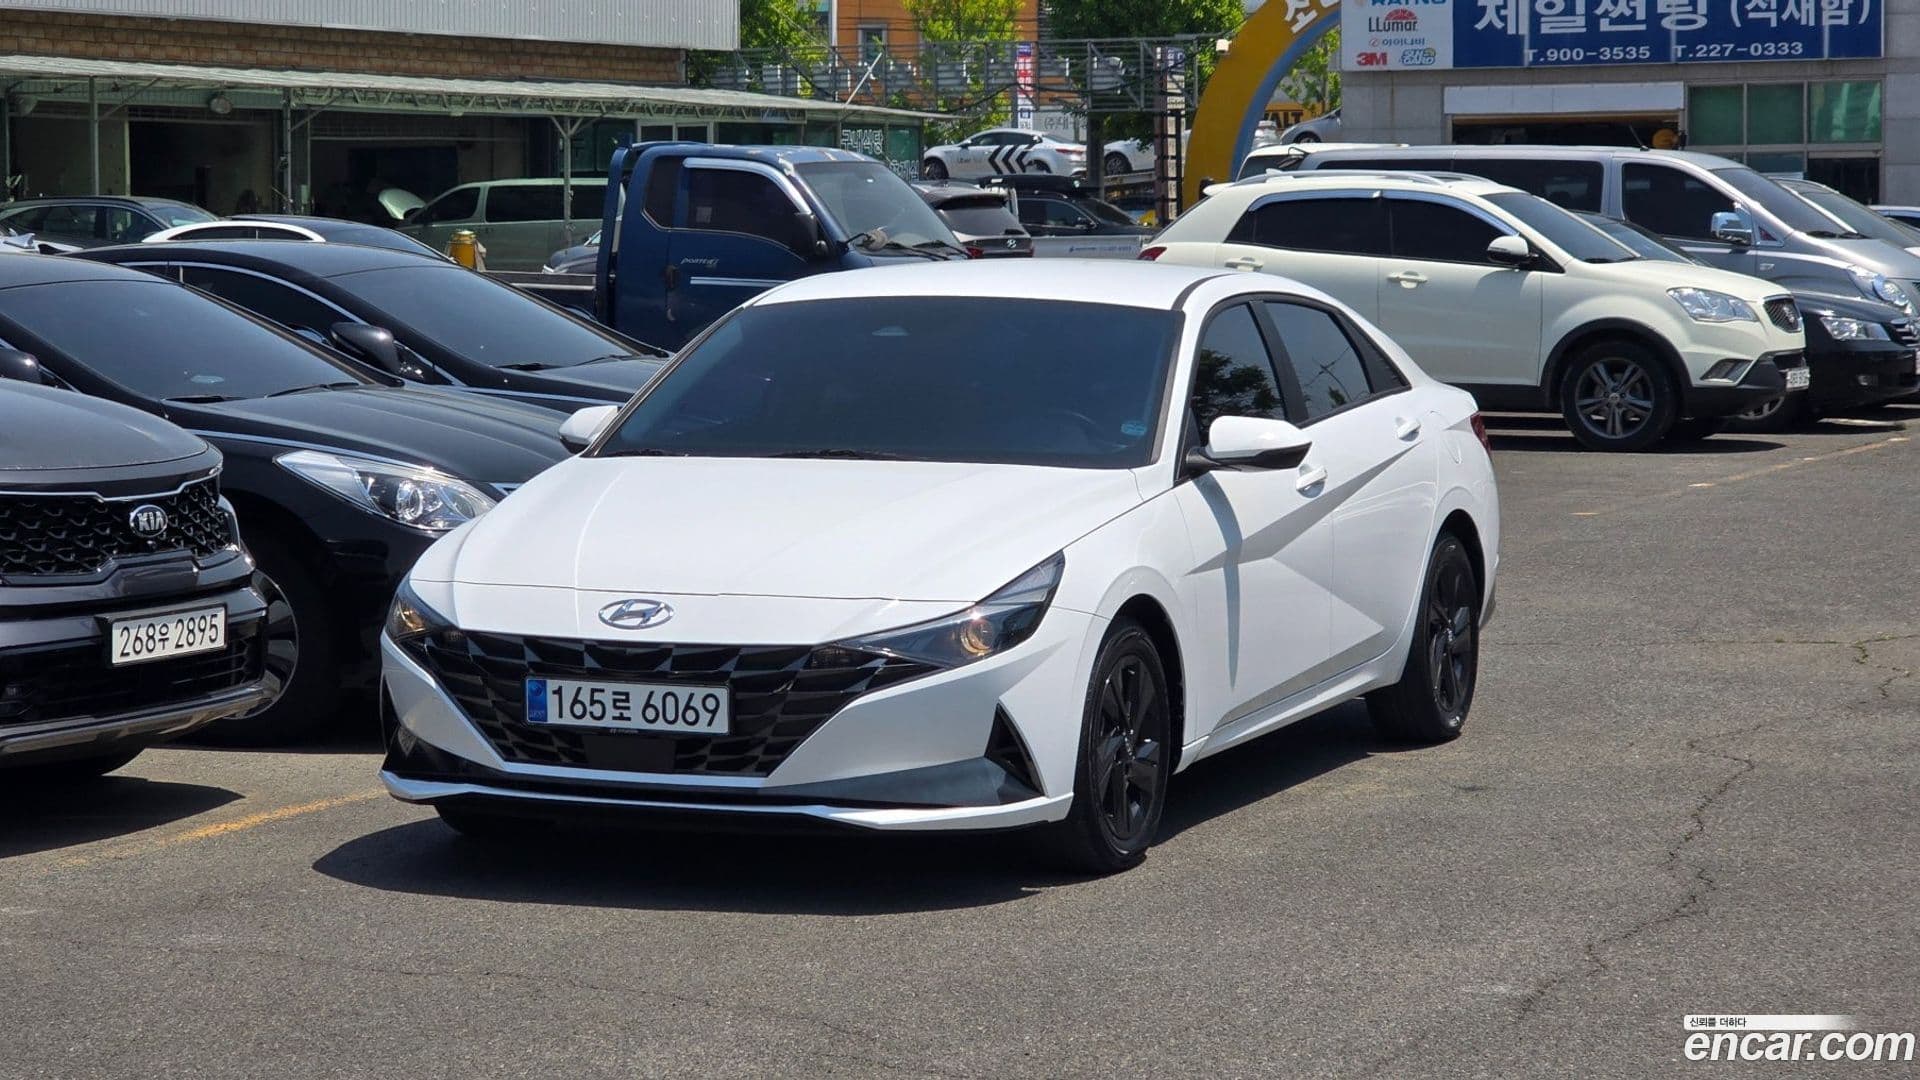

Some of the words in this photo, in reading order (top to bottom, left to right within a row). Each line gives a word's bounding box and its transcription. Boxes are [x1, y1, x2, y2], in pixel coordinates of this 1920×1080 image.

[1368, 17, 1418, 32] LLumar
[1474, 0, 1708, 35] 제일썬팅
[1382, 38, 1425, 46] 아이나비
[1528, 46, 1651, 62] T.900-3535
[1675, 42, 1804, 58] T.227-0333
[1356, 52, 1388, 66] 3M
[138, 511, 165, 531] KIA
[119, 621, 170, 658] 268우
[174, 613, 219, 650] 2895
[552, 685, 632, 722] 165로
[641, 690, 721, 728] 6069
